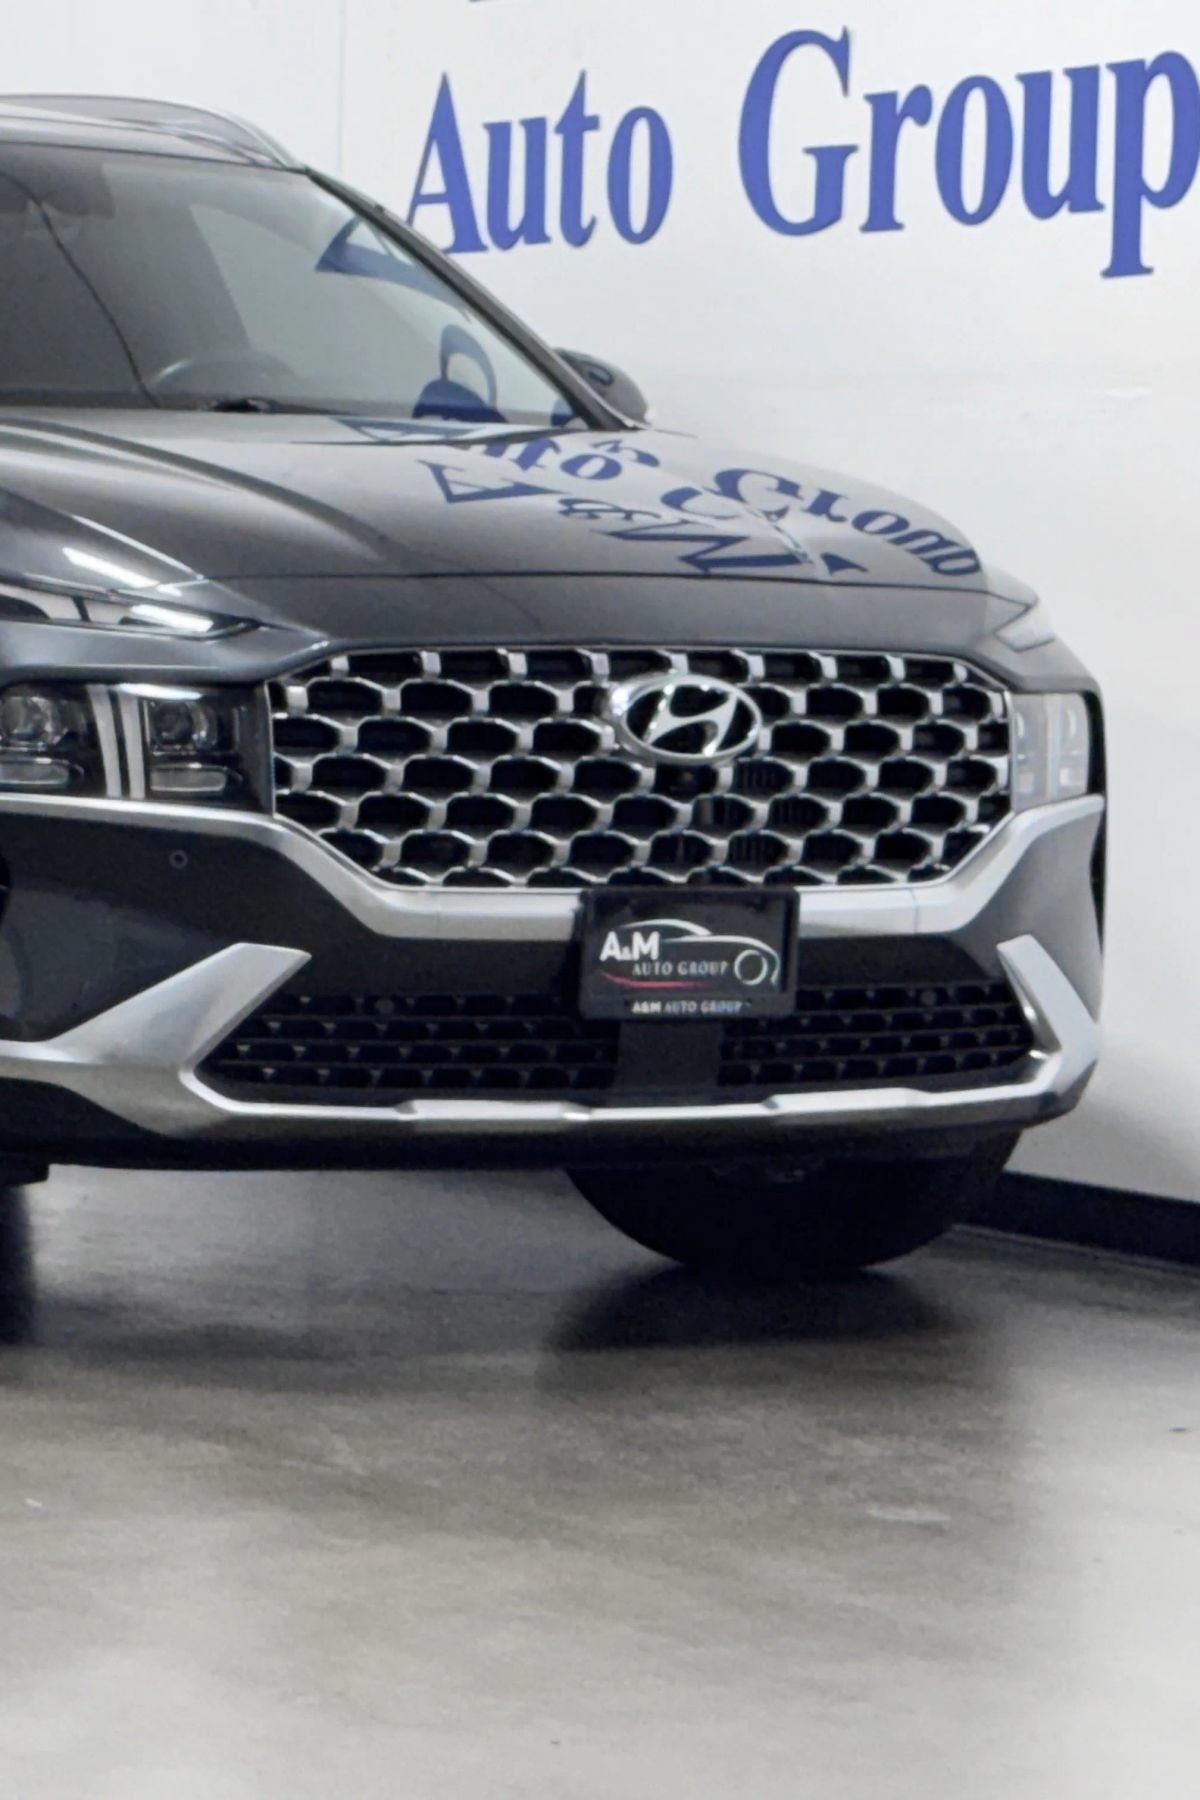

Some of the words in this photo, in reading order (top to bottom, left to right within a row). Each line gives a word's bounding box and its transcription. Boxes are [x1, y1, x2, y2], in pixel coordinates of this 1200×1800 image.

[407, 70, 673, 255] Auto
[738, 26, 1200, 279] Group
[599, 931, 660, 962] A&M
[632, 961, 673, 976] AUTO
[677, 961, 729, 976] GROUP
[663, 1000, 698, 1014] AUTO
